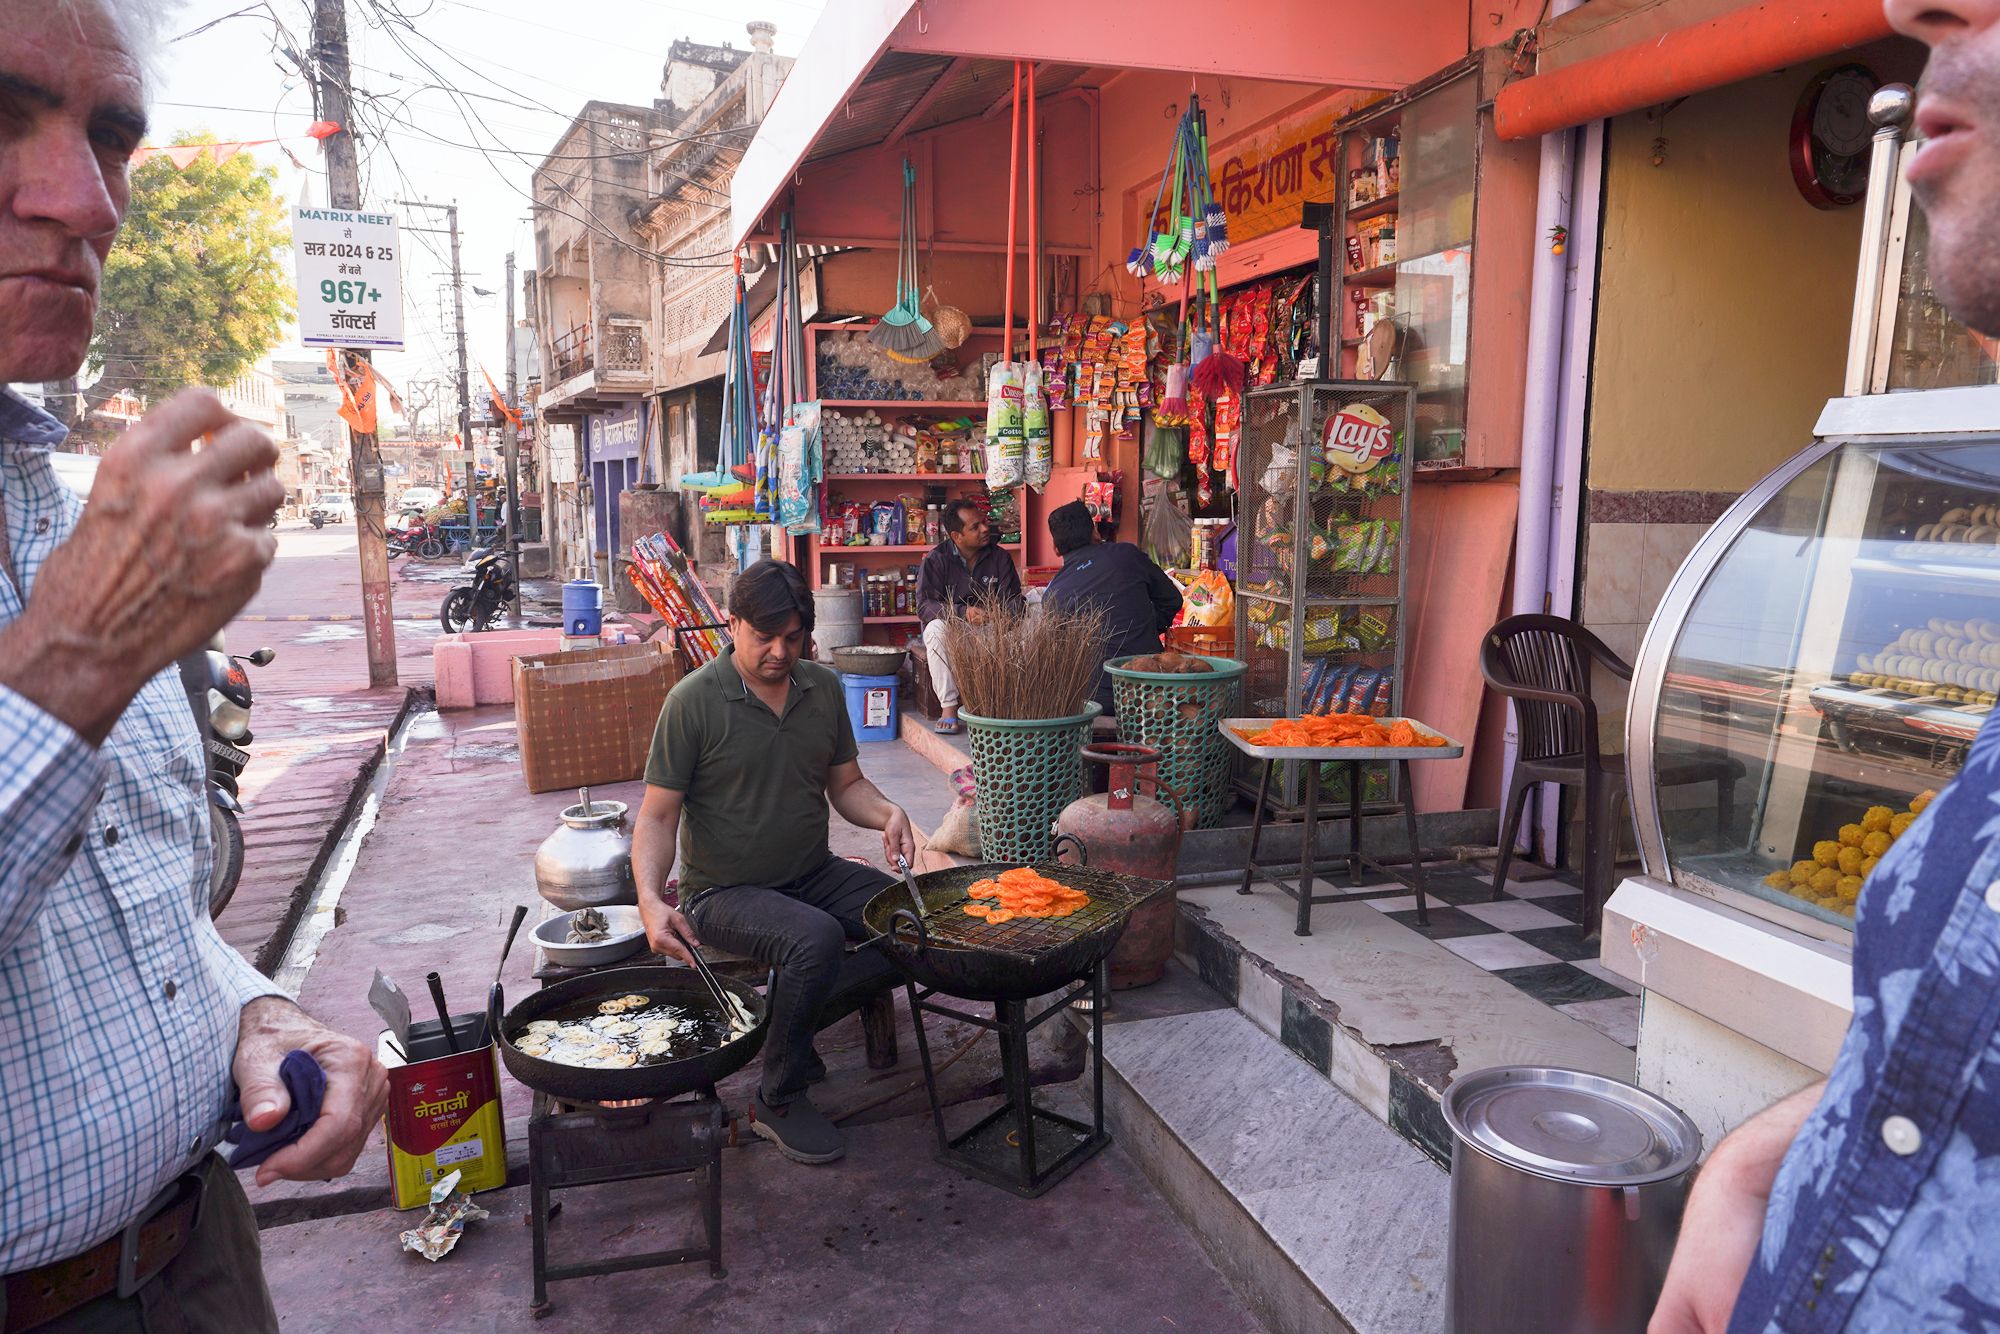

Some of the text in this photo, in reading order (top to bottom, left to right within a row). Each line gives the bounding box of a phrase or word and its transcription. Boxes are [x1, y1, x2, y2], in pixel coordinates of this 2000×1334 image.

[299, 208, 392, 226] MATRIX NEET
[344, 227, 352, 239] से
[304, 242, 393, 261] सत्र 2024 & 25
[338, 263, 362, 276] में बने
[320, 279, 382, 305] 967+
[330, 309, 376, 330] डॉक्टर्स
[413, 1090, 469, 1118] नेताजी
